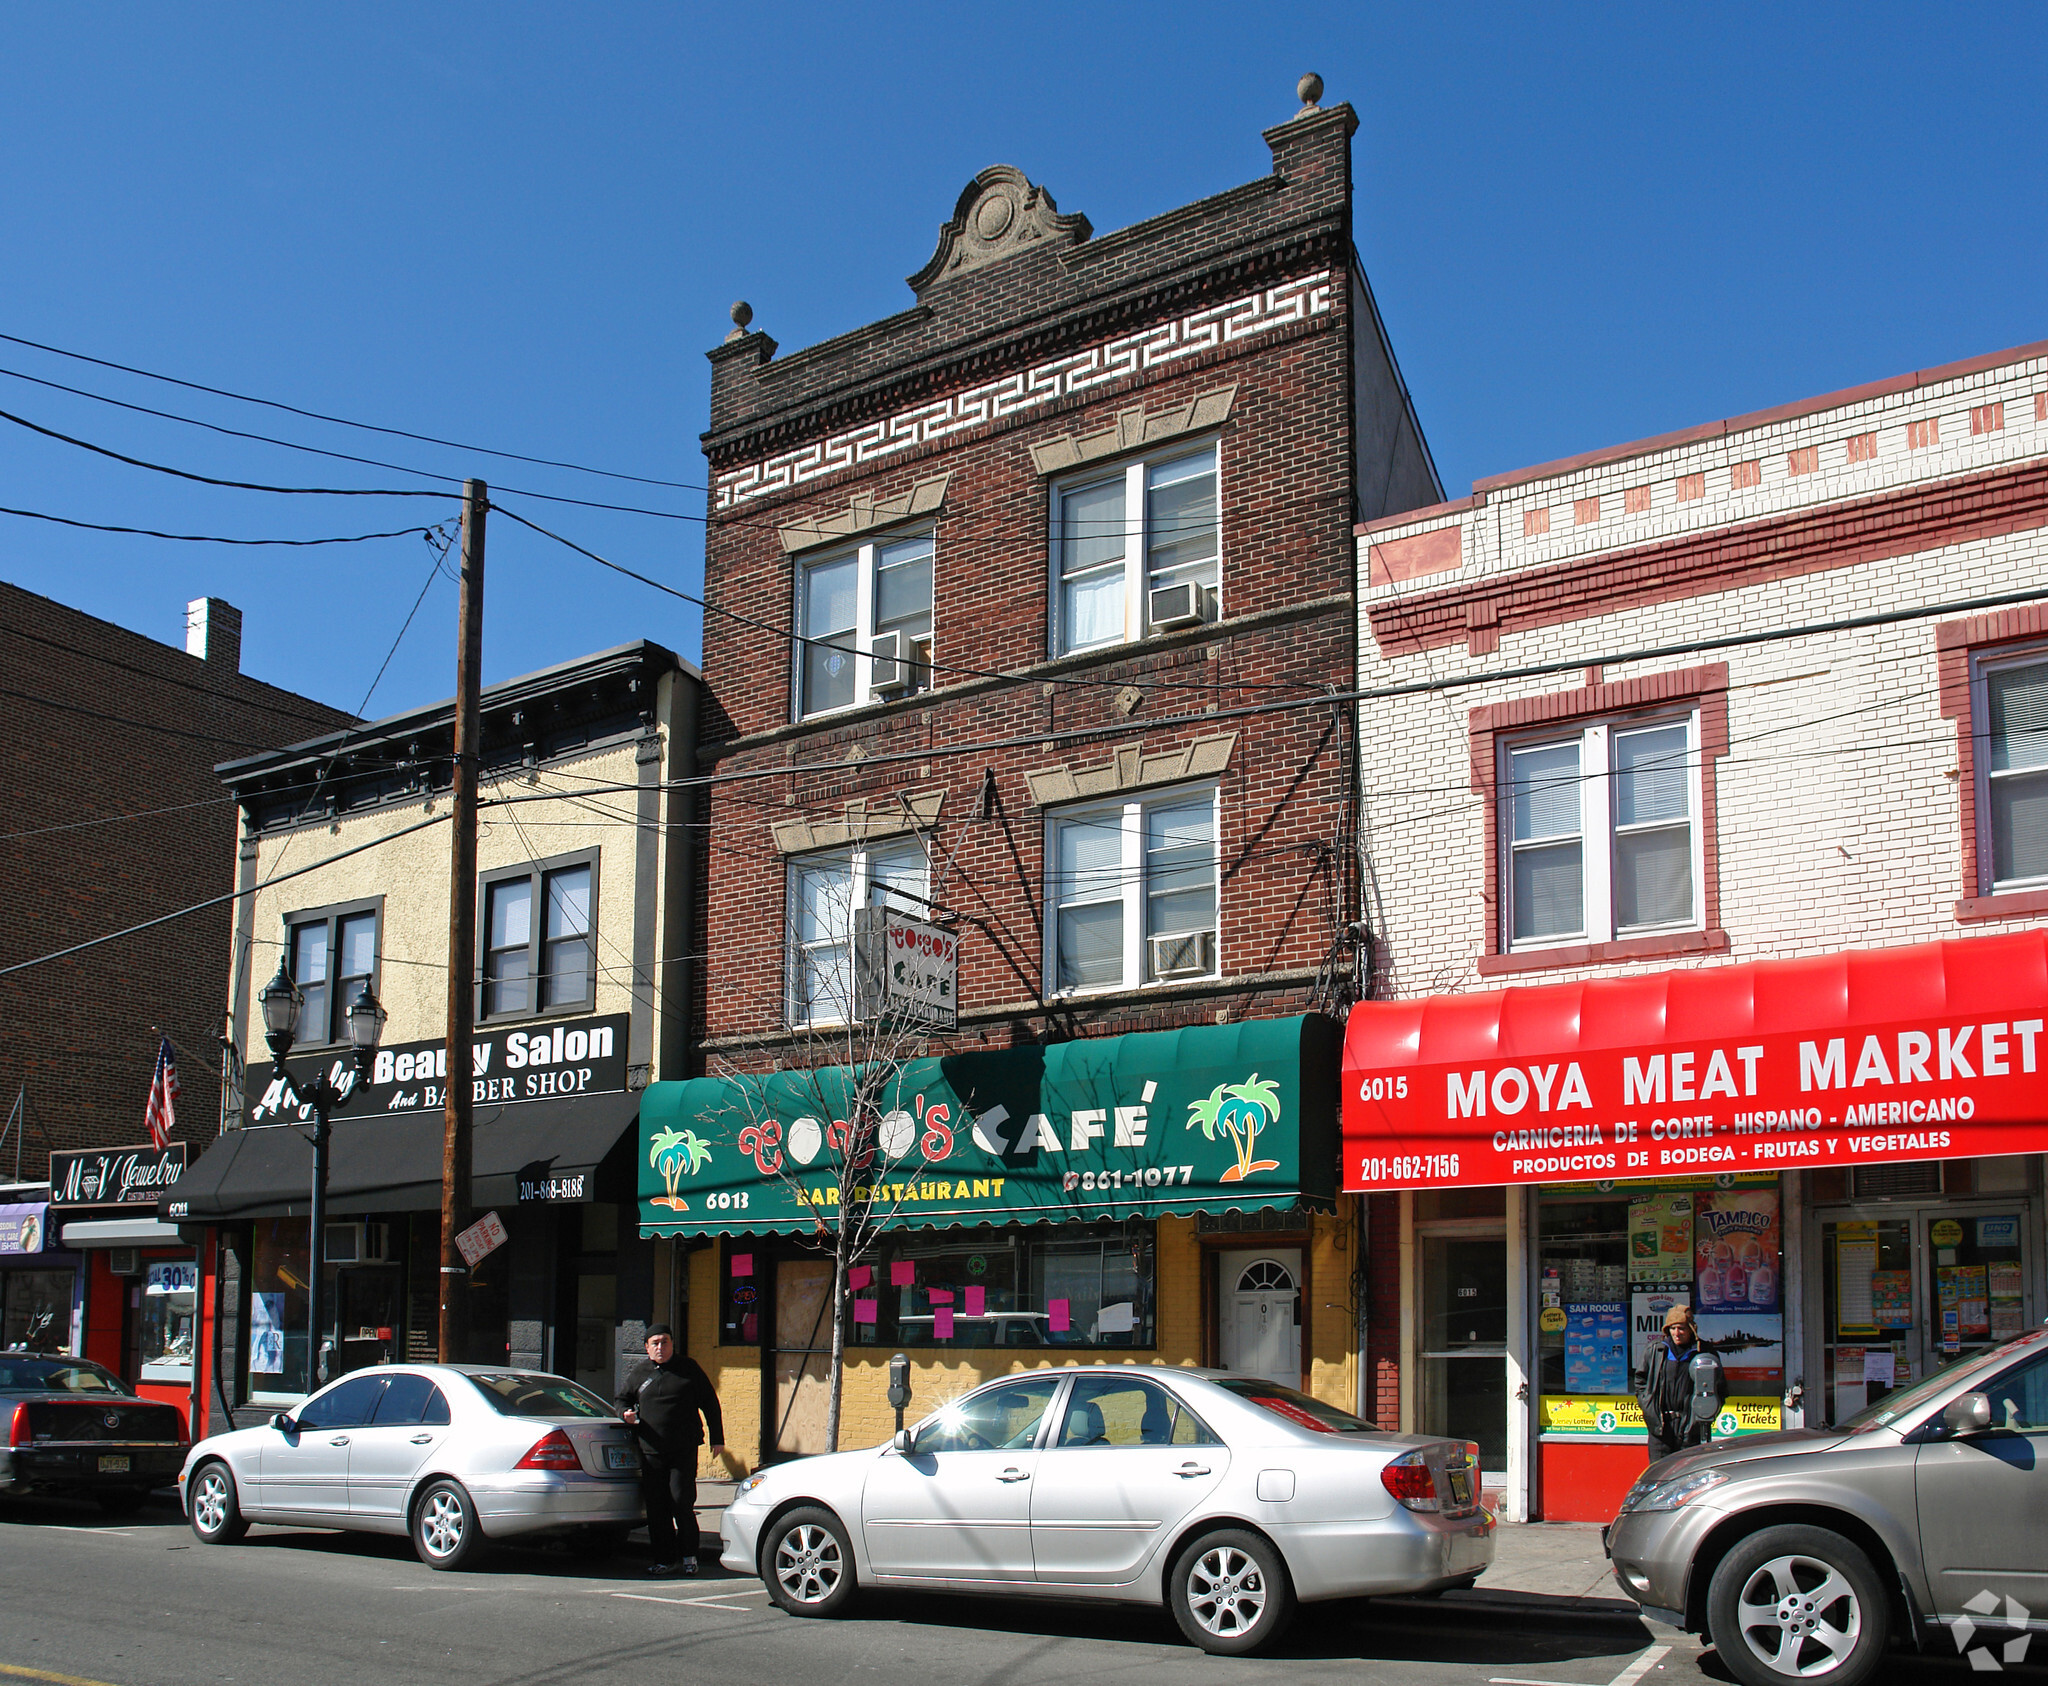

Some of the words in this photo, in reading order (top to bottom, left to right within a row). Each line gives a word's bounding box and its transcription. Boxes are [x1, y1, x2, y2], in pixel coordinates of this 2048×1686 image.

[373, 1042, 492, 1085] Beauy
[506, 1025, 614, 1069] Salon
[1447, 1061, 1593, 1119] MOYA
[1622, 1045, 1764, 1106] MEAT
[1799, 1019, 2044, 1092] MARKET
[388, 1090, 418, 1110] And
[424, 1077, 515, 1108] BABER
[525, 1067, 592, 1097] SHOP
[1359, 1076, 1408, 1102] 6015
[972, 1079, 1158, 1156] CAFÉ
[1492, 1124, 1604, 1152] CARNICERIA
[1614, 1121, 1638, 1144] DE
[1650, 1116, 1713, 1142] CORTE
[1734, 1107, 1822, 1136] HISPANO
[1844, 1096, 1975, 1128] AMERICANO
[1512, 1153, 1616, 1175] PRODUCTOS
[1627, 1151, 1649, 1167] DE
[1660, 1145, 1736, 1166] BODEGA
[1753, 1140, 1820, 1160] FRUTAS
[1826, 1138, 1838, 1155] Y
[1848, 1131, 1951, 1154] VEGETALES
[1081, 1165, 1194, 1192] 861-1077
[1361, 1154, 1460, 1181] 201-662-7156
[520, 1178, 583, 1200] 201-868-8188
[705, 1191, 749, 1210] 6013
[796, 1186, 840, 1207] BAR
[854, 1177, 1005, 1202] RESTAURANT
[168, 1201, 189, 1217] 6011
[1702, 1210, 1771, 1233] TAMPICO
[477, 1221, 495, 1250] PARKING
[488, 1222, 500, 1236] NO
[161, 1265, 190, 1291] 30%
[1569, 1304, 1588, 1313] SAN
[1589, 1303, 1621, 1313] ROQUE
[361, 1327, 377, 1338] OPEN
[1735, 1402, 1774, 1414] Lottery
[1741, 1412, 1778, 1424] Tickets
[1573, 1417, 1595, 1426] Lottery
